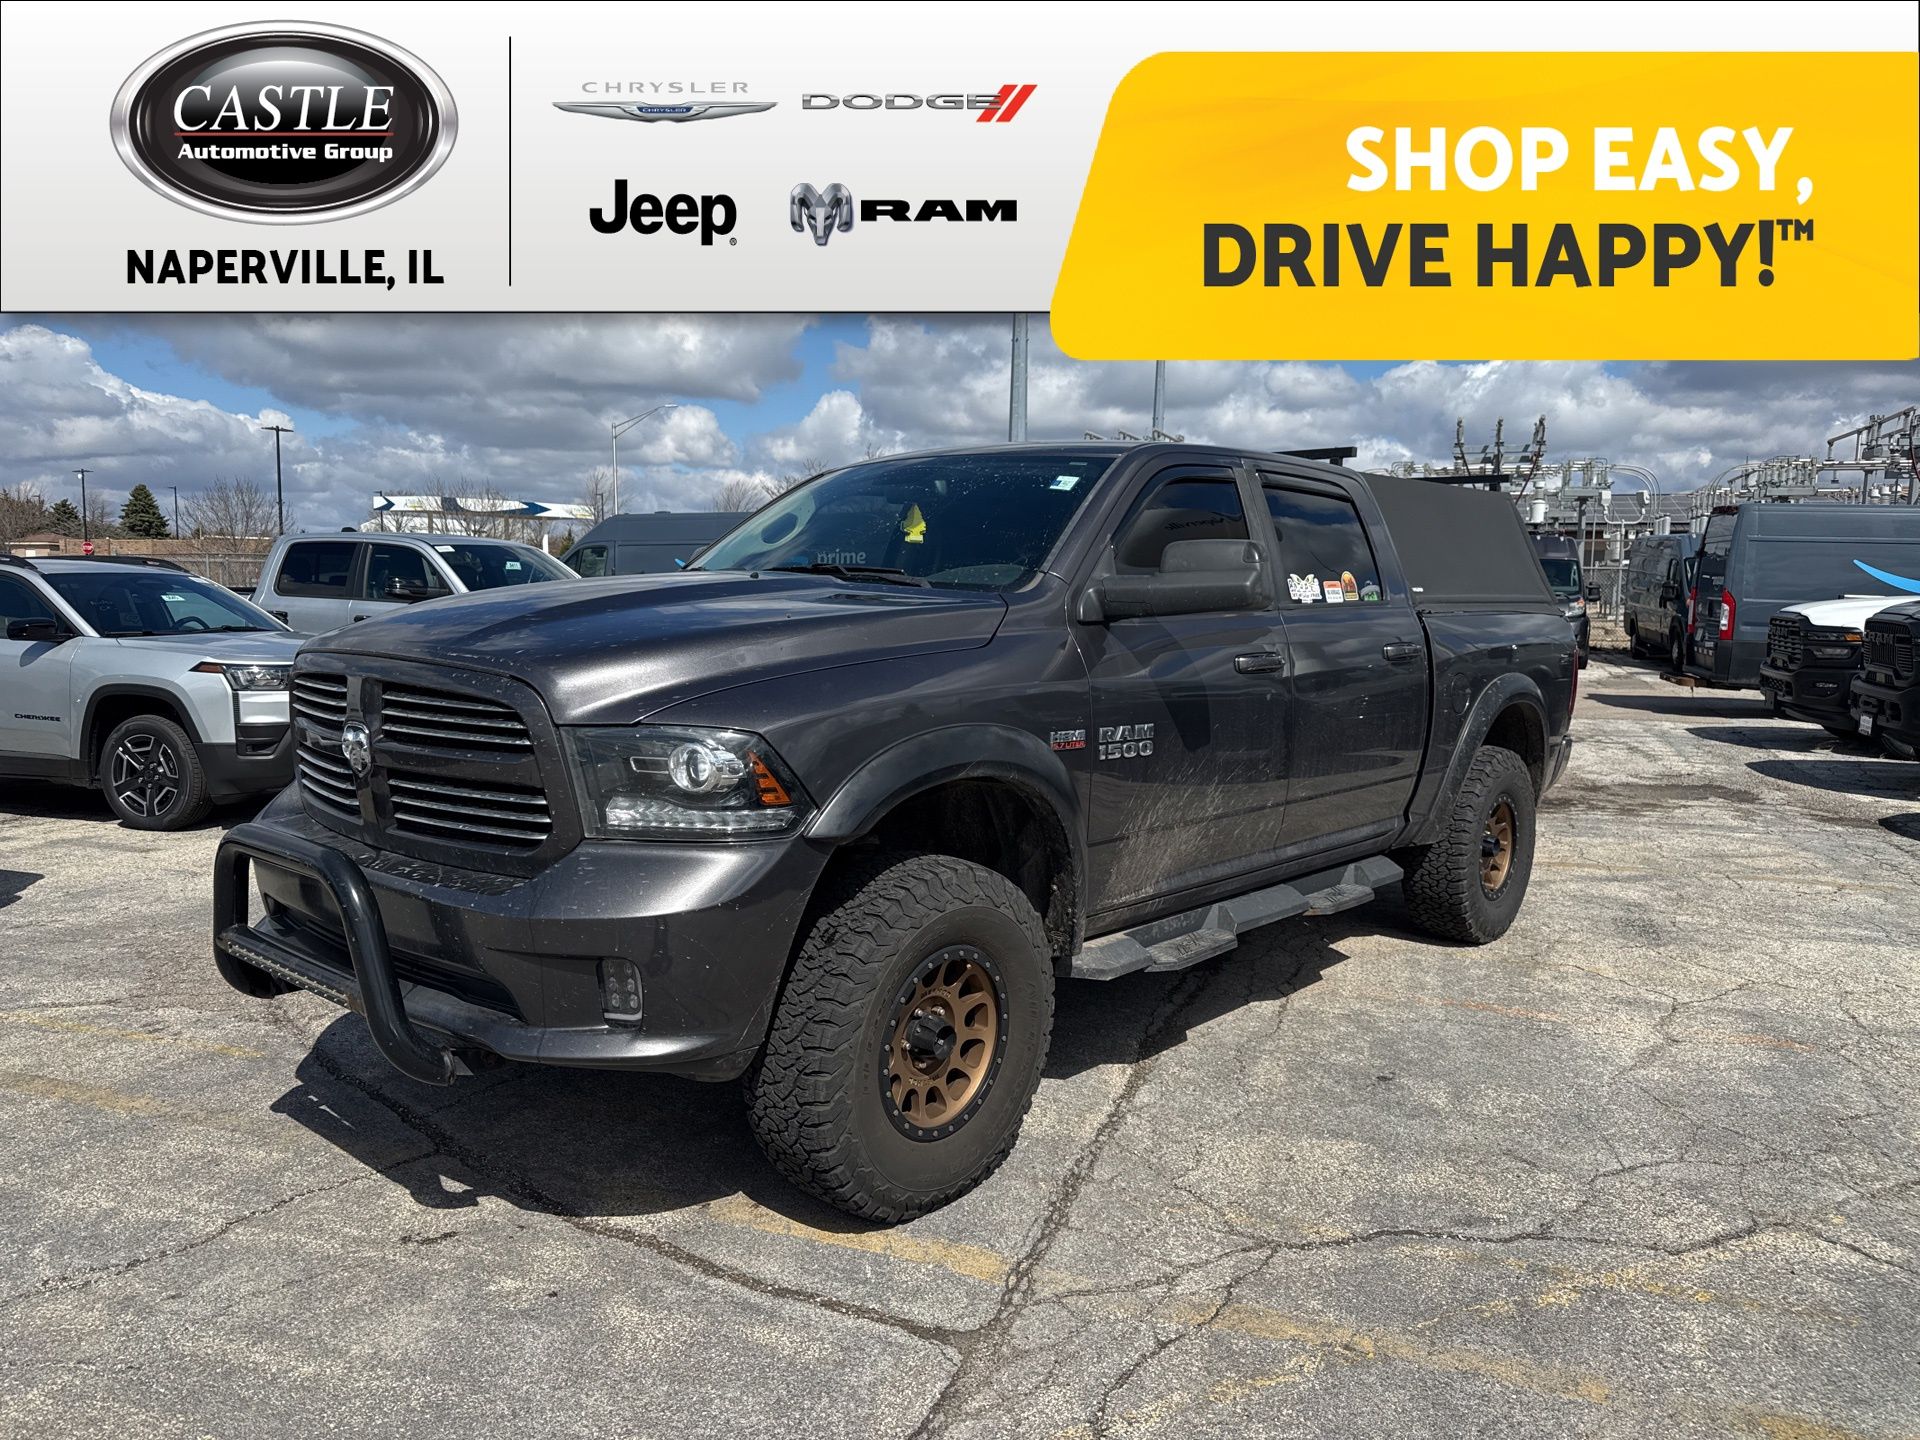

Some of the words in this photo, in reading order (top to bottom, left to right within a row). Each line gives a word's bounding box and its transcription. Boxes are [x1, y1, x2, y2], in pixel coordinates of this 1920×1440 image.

[14, 713, 62, 722] CHEROKEE
[1099, 723, 1154, 743] RAM
[1099, 740, 1153, 760] 1500
